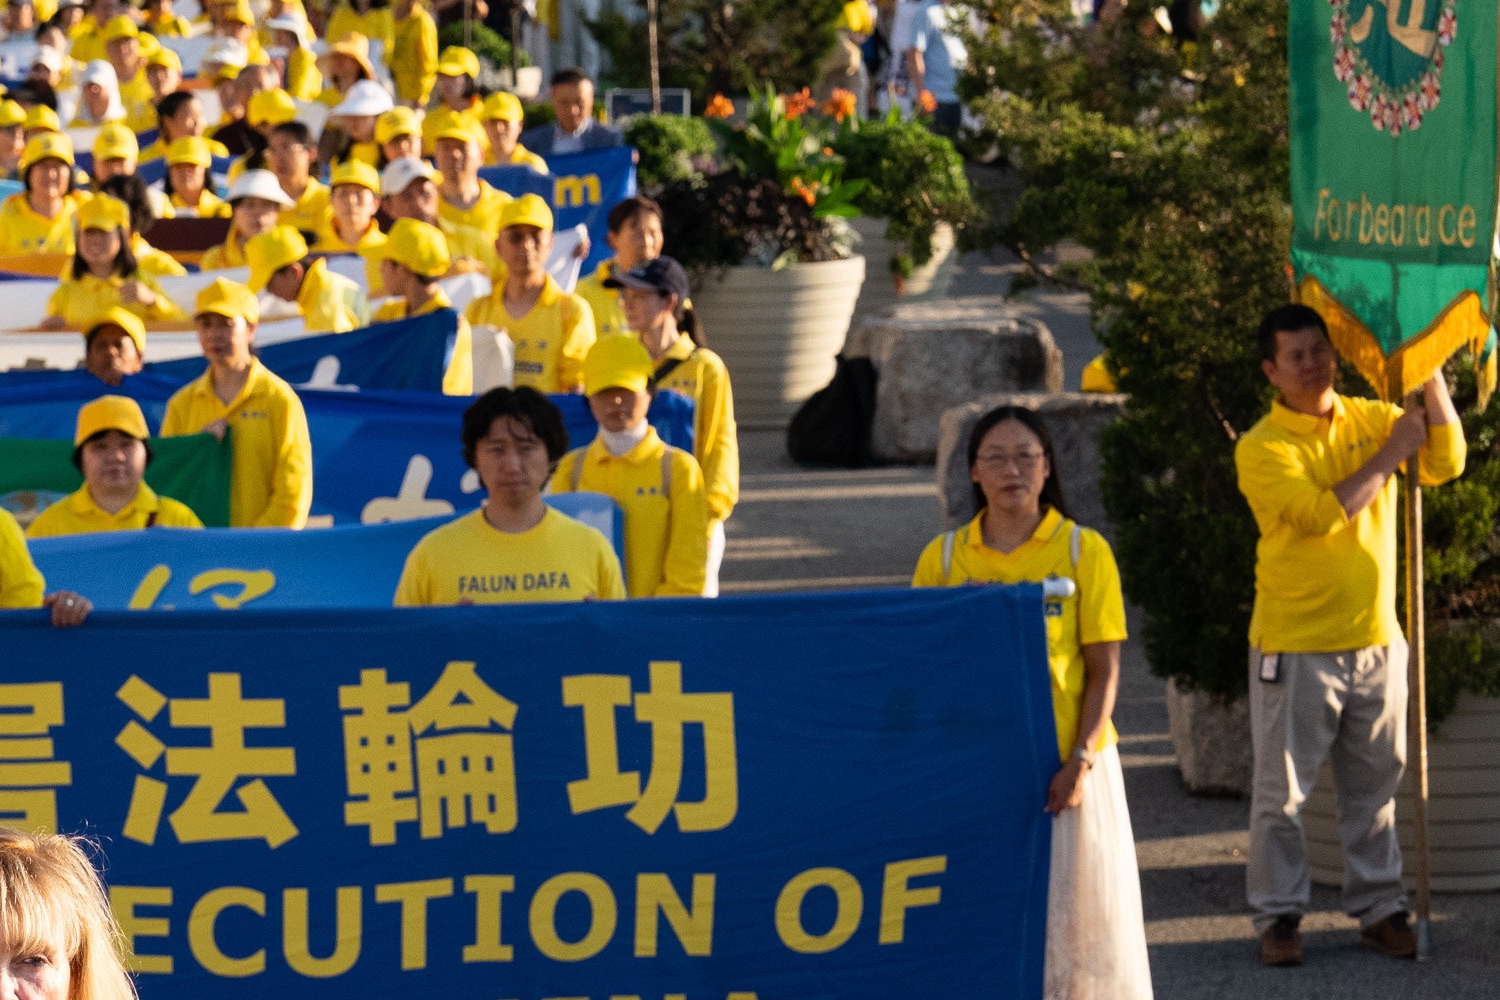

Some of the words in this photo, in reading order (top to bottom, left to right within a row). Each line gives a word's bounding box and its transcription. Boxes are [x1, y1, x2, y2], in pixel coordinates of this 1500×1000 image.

[1314, 188, 1477, 248] Forbeaace
[458, 575, 517, 594] FALUN
[523, 572, 571, 592] DAFA
[775, 856, 947, 953] OF
